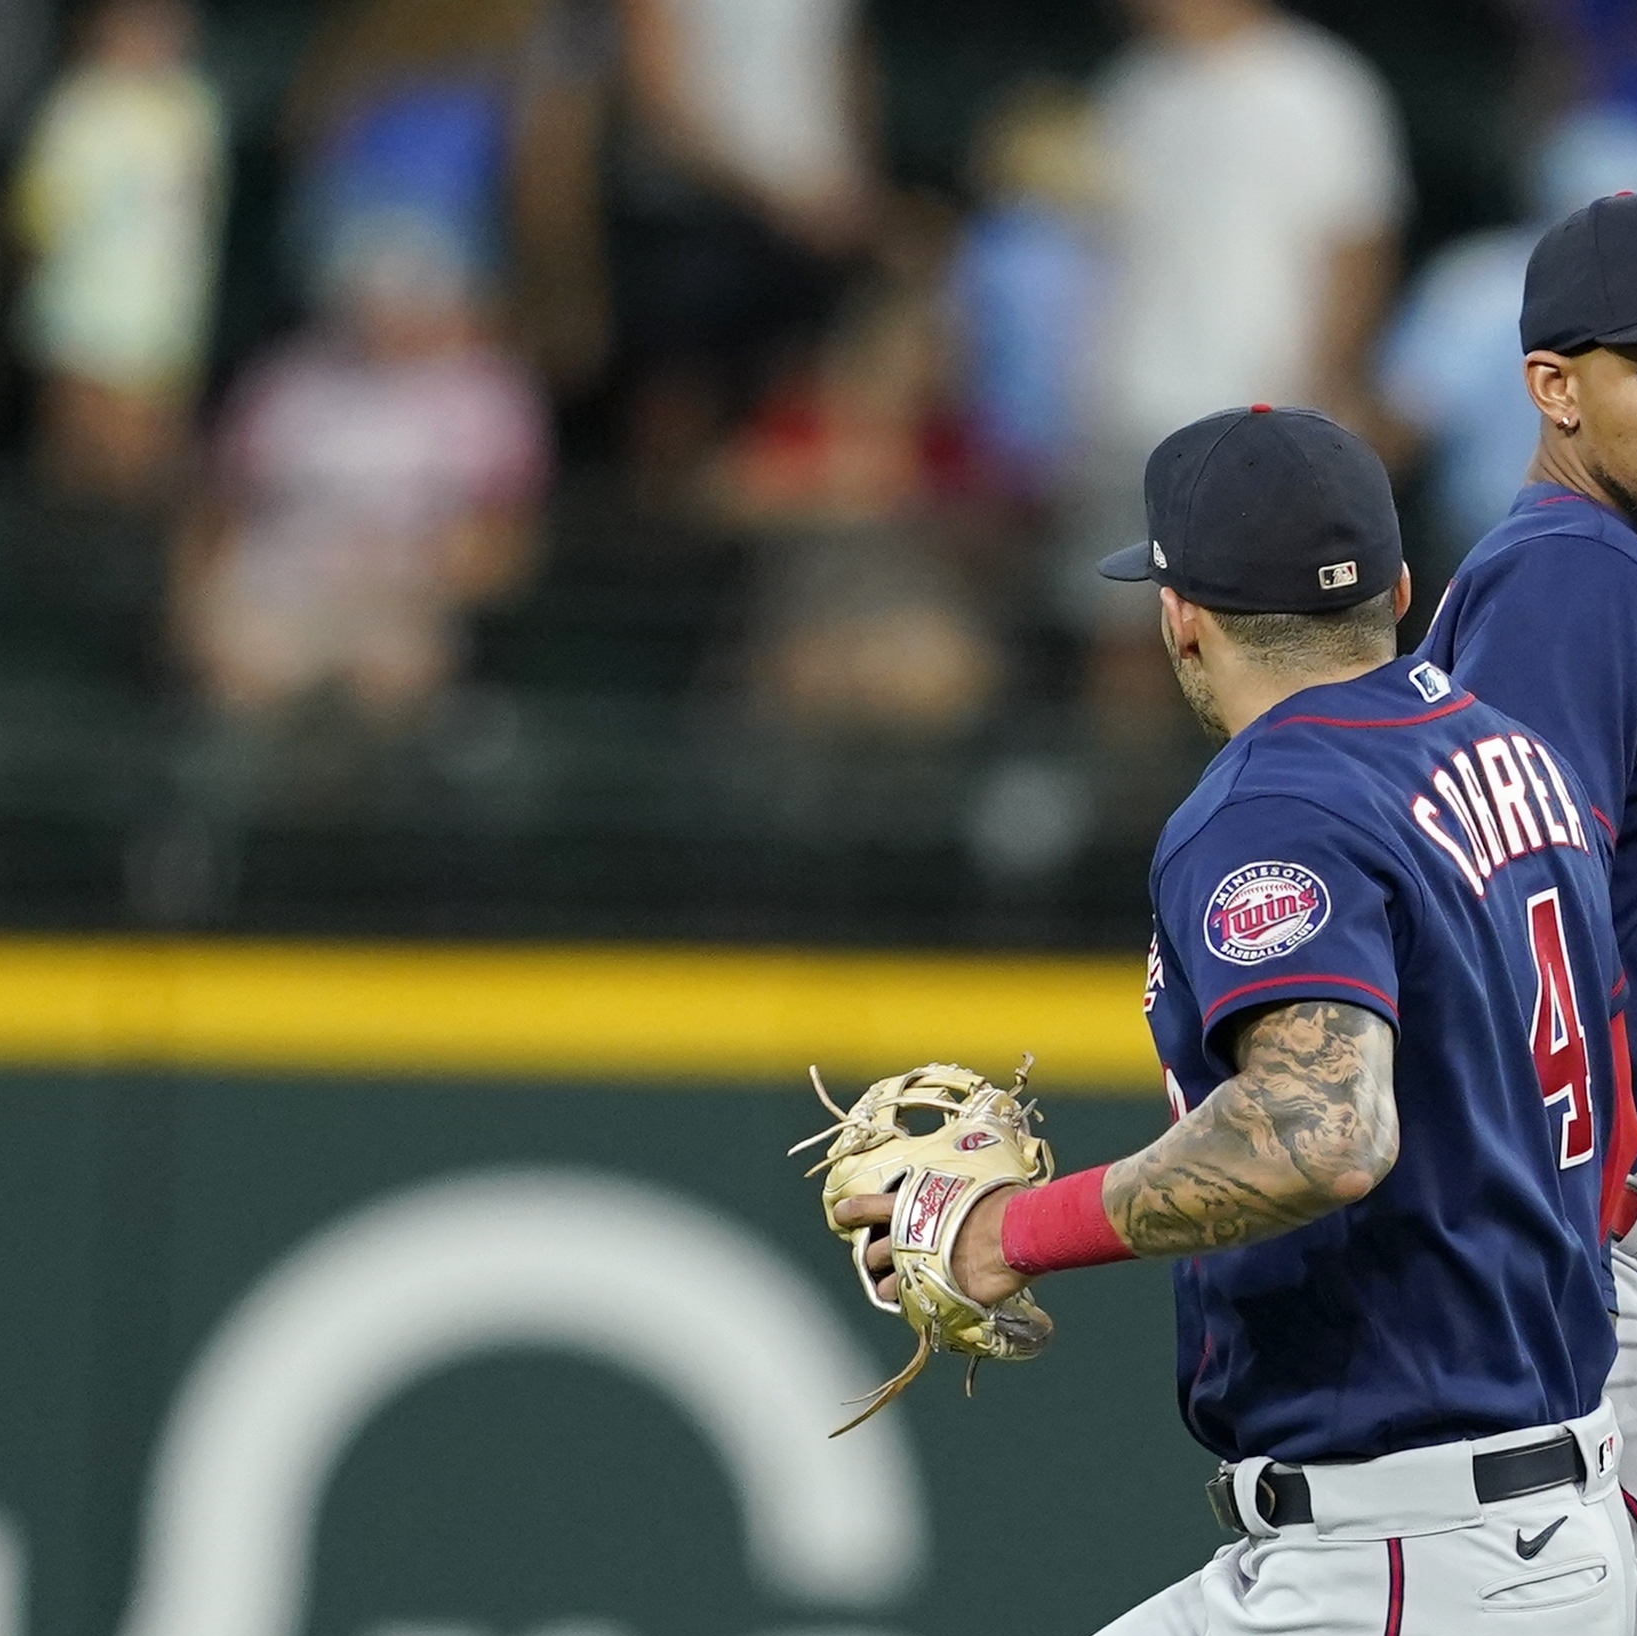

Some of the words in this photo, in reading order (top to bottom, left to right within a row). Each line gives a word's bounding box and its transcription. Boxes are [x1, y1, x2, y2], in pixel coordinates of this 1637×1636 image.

[1410, 732, 1591, 904] CORREA
[1210, 887, 1320, 943] Twins
[1216, 866, 1314, 906] MINNESOTA
[1219, 942, 1284, 960] BASEBALL
[1285, 922, 1315, 946] CLUB
[1527, 887, 1594, 1170] 4
[909, 1174, 945, 1242] Rawlings
